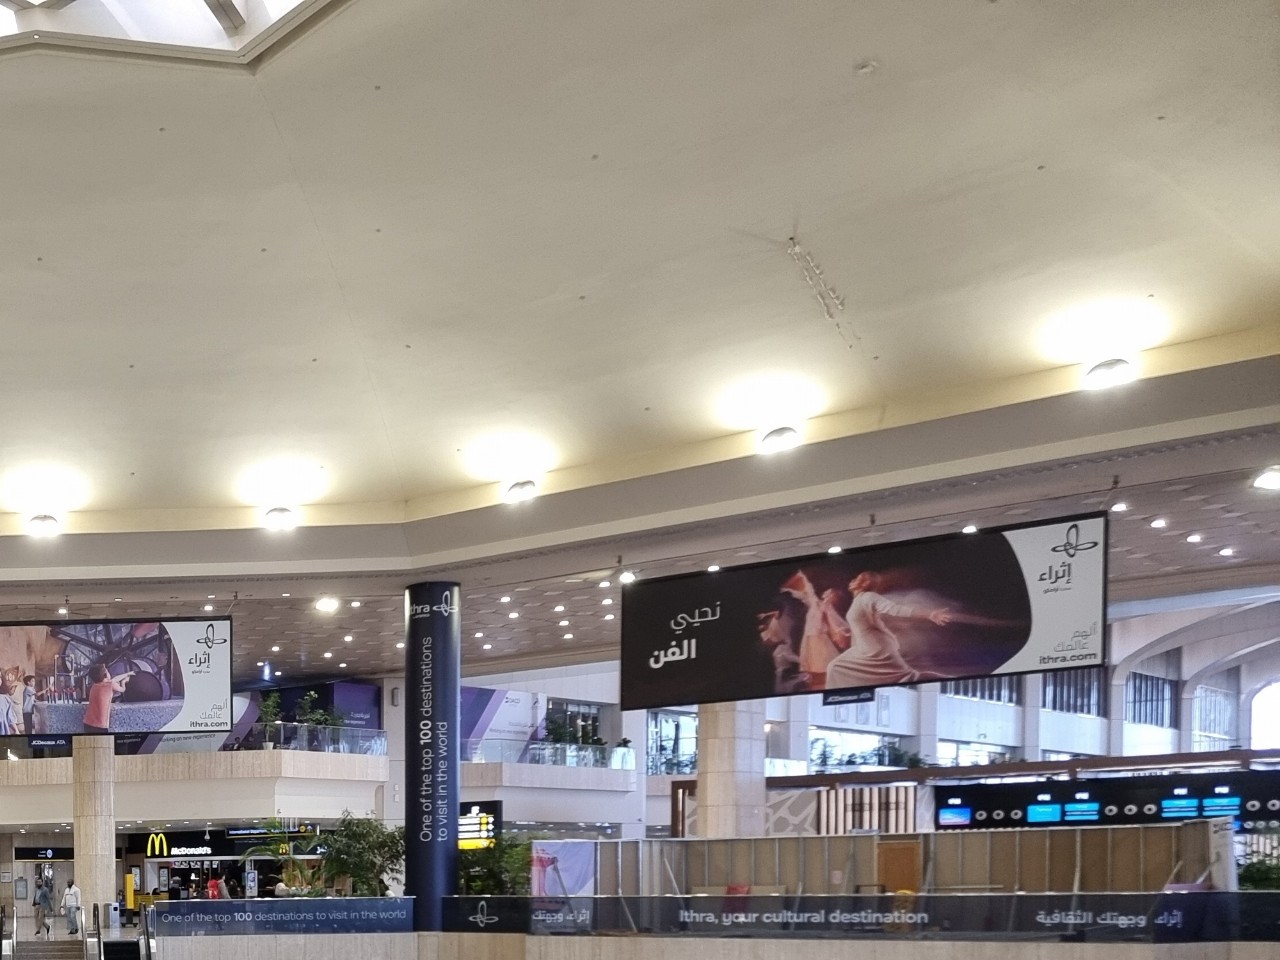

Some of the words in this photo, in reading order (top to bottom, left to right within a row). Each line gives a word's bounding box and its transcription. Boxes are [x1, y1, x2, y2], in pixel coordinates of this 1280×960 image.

[1038, 561, 1072, 584] إثراء
[670, 601, 721, 634] نحيي
[188, 651, 210, 668] إثراء
[649, 638, 696, 669] الفن
[1039, 653, 1097, 665] ithra.com
[420, 637, 432, 716] destinations
[420, 720, 432, 745] 100
[436, 722, 448, 757] world
[420, 748, 435, 771] top
[436, 760, 448, 782] the
[420, 774, 432, 796] the
[436, 784, 448, 796] in
[420, 798, 432, 811] of
[436, 799, 448, 826] visit
[420, 816, 432, 842] One
[437, 828, 448, 841] to
[171, 846, 212, 855] McDonald's
[162, 913, 182, 923] One
[184, 913, 195, 922] of
[196, 913, 212, 922] the
[214, 913, 231, 924] top
[234, 912, 252, 921] 100
[255, 912, 314, 921] destinations
[316, 912, 326, 921] to
[328, 911, 348, 920] visit
[350, 911, 359, 920] in
[361, 910, 377, 920] the
[379, 909, 407, 920] world
[532, 910, 564, 923] وجهتك
[680, 909, 719, 924] Ithra,
[722, 911, 760, 926] your
[762, 909, 825, 923] cultural
[828, 909, 929, 924] destination
[1035, 910, 1092, 924] الثقافية
[1096, 911, 1147, 928] وجهتك
